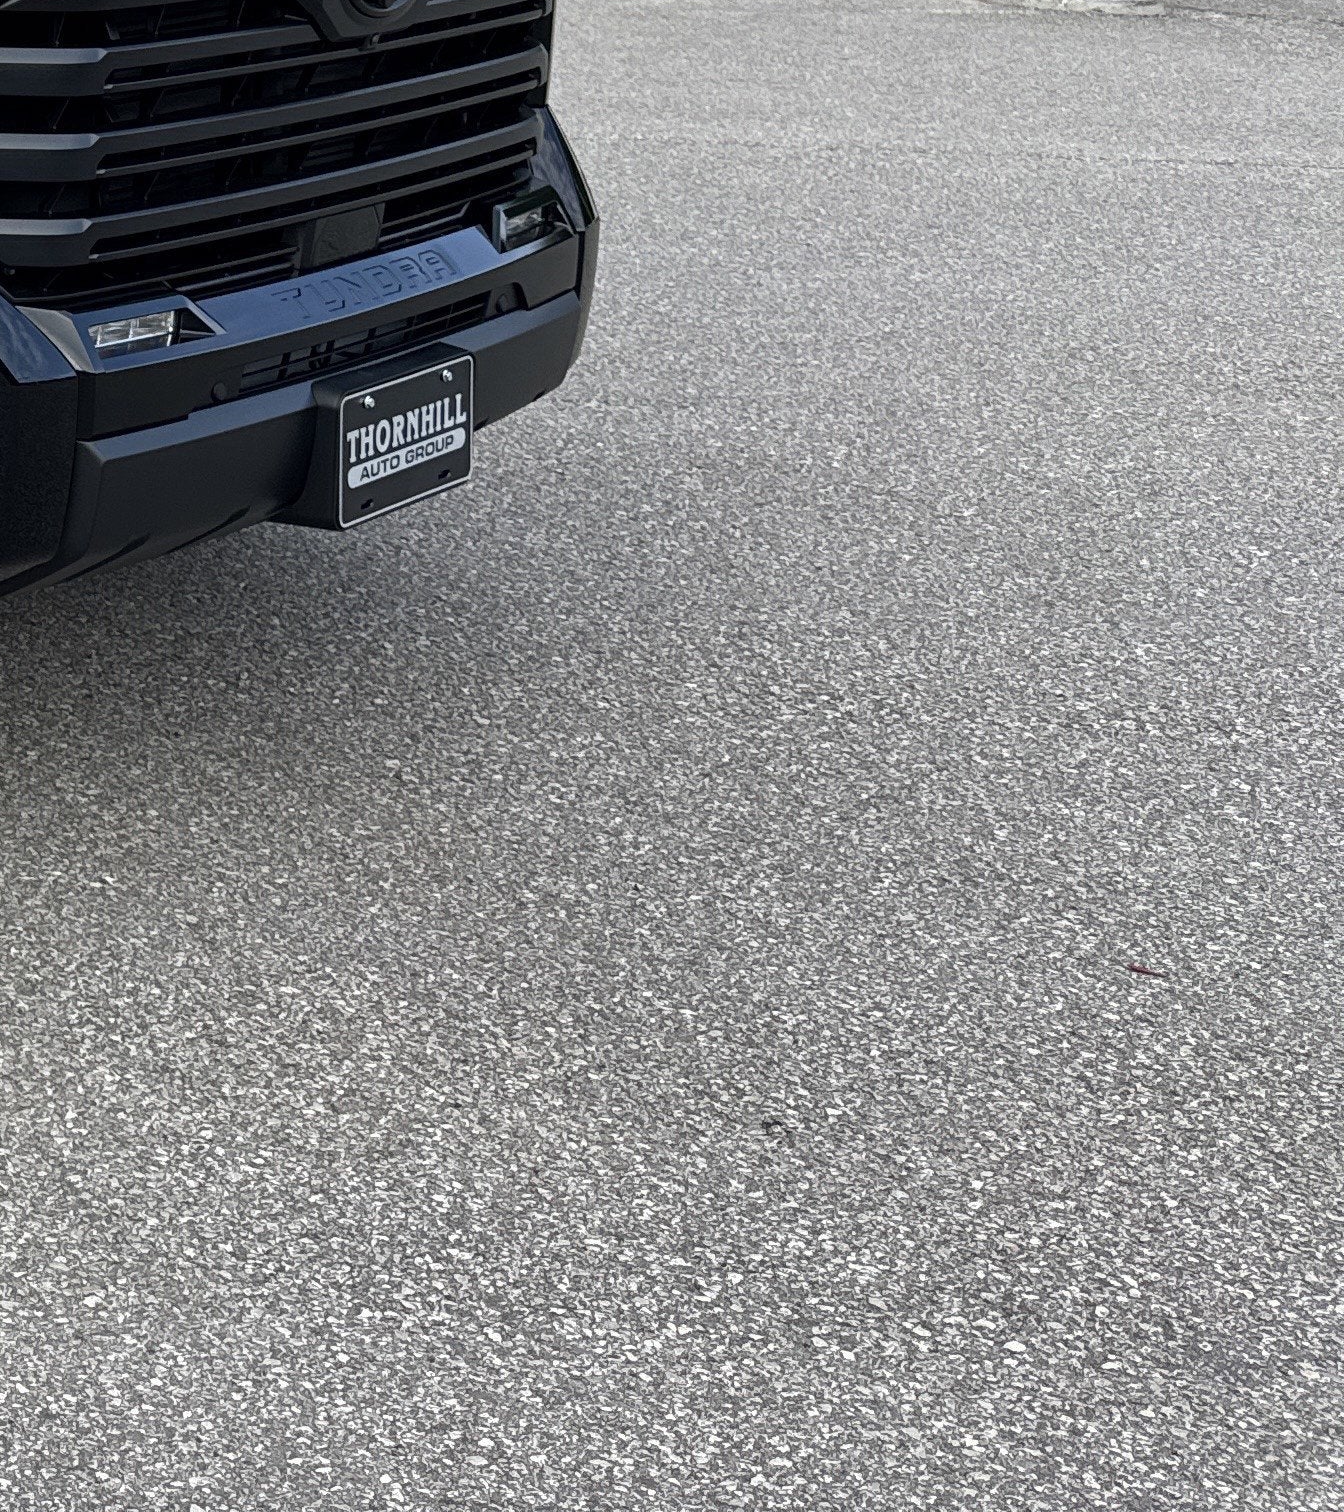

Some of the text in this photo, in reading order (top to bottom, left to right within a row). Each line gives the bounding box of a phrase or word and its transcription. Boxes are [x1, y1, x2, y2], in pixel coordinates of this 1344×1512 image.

[270, 249, 460, 320] TUNDRA
[346, 393, 467, 463] THORNHILL
[360, 434, 455, 482] AUTO GROUP
